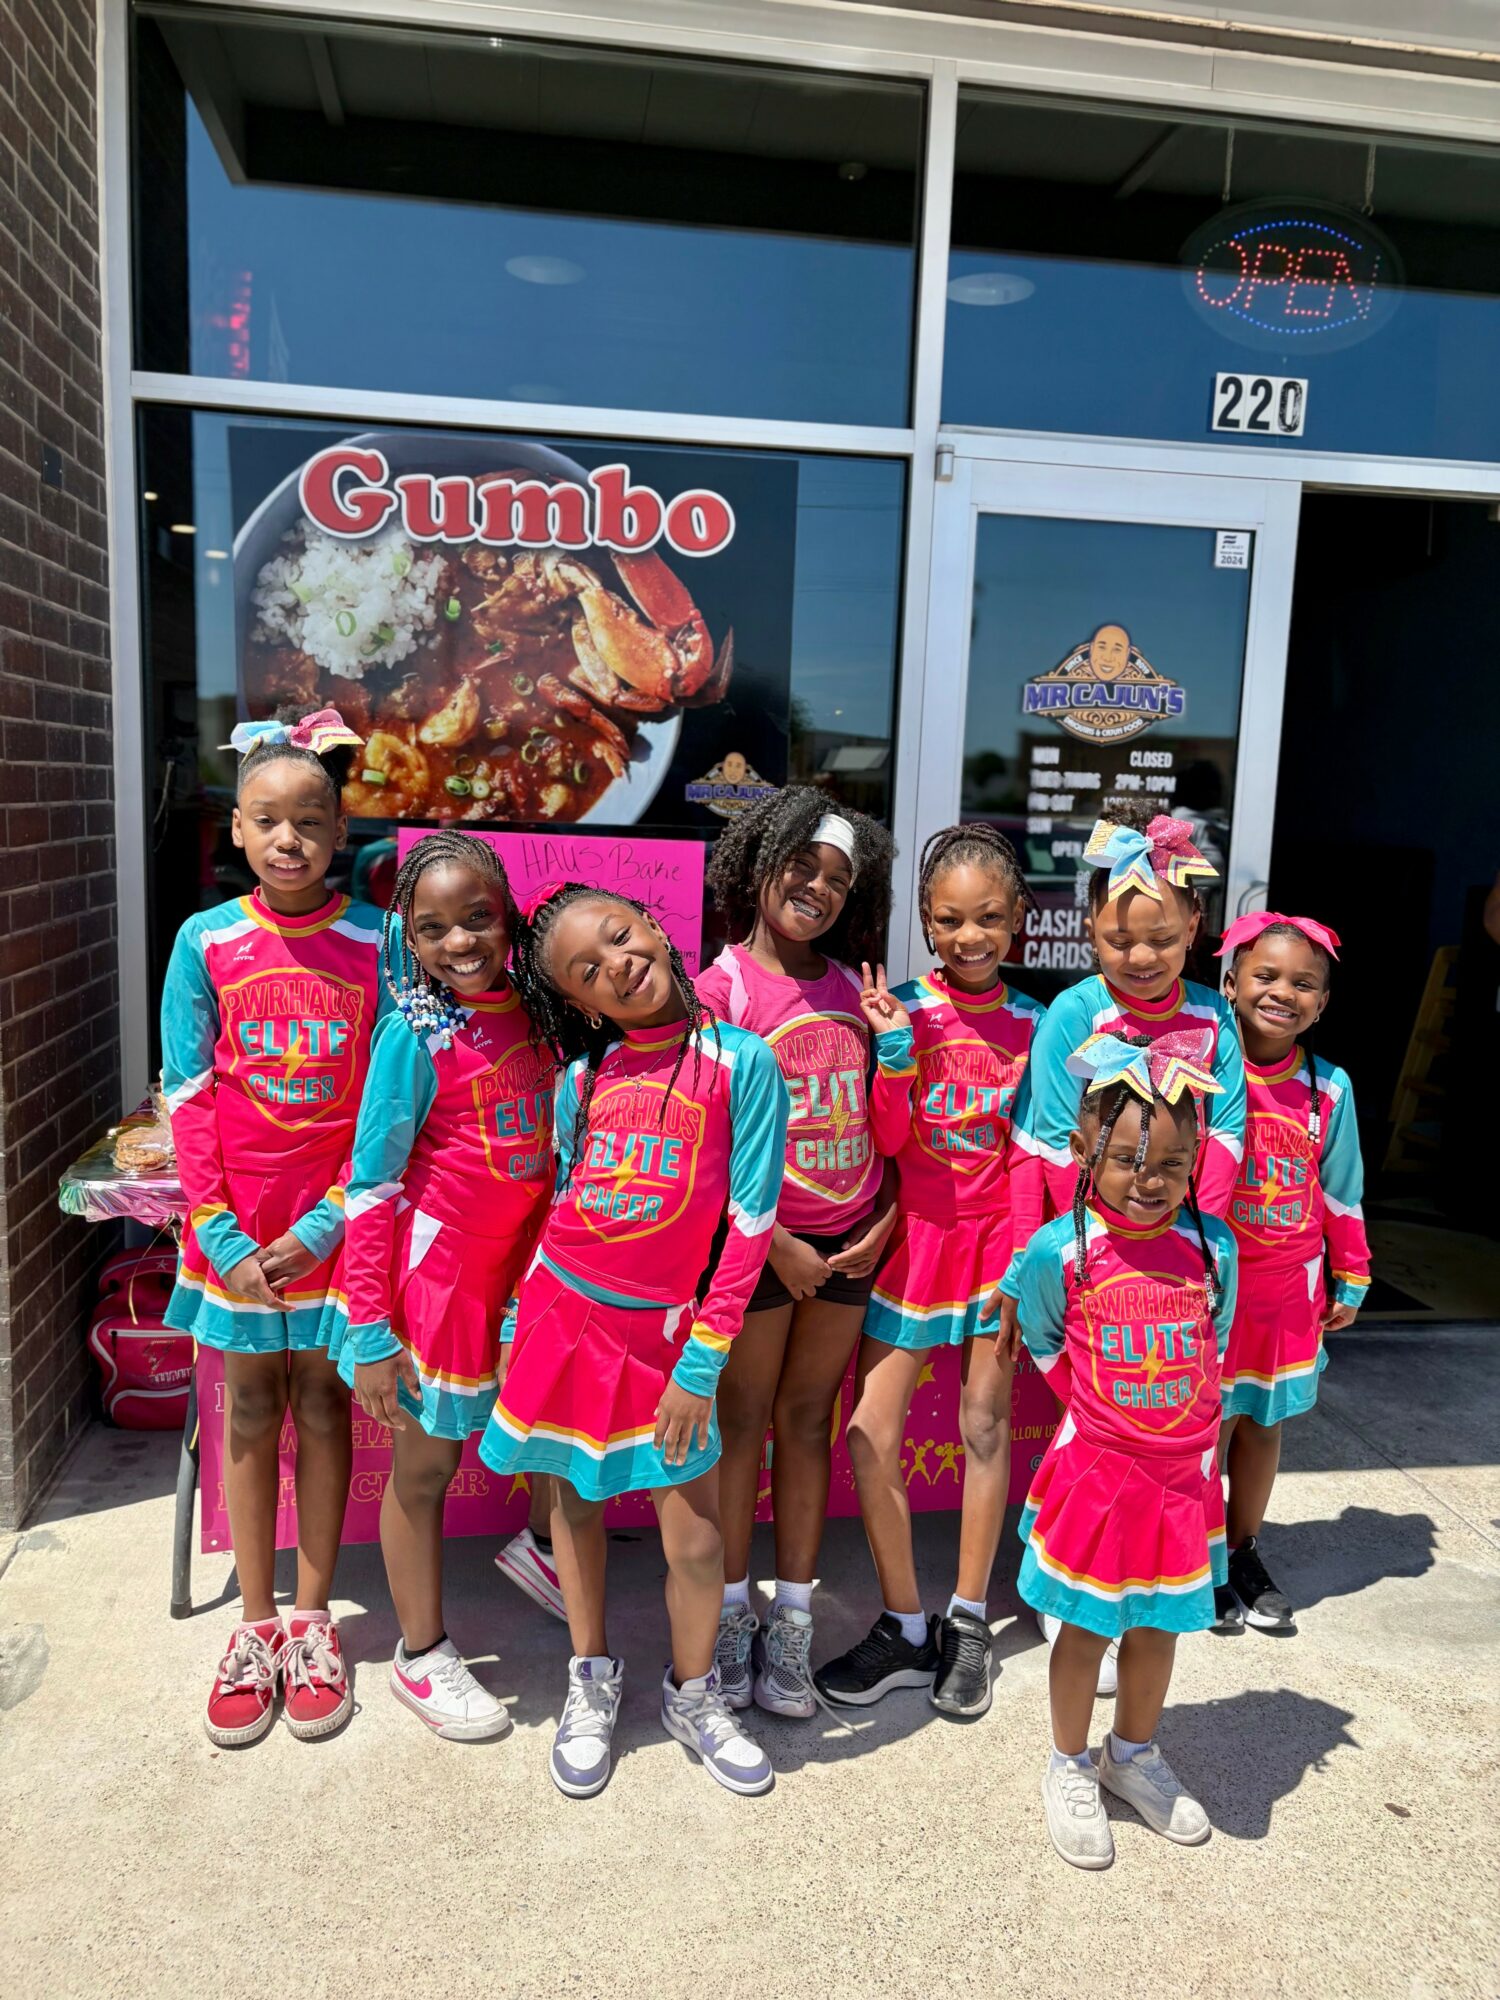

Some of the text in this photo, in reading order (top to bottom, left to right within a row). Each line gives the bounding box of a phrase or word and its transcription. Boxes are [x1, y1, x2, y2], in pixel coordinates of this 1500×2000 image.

[1198, 240, 1380, 320] OPEN
[1217, 376, 1303, 433] 220
[300, 447, 736, 557] Gumbo
[1221, 556, 1243, 565] 2024
[1064, 655, 1083, 672] SINCE
[1023, 683, 1186, 715] MR CAJUN'S
[1124, 718, 1144, 735] FOOD
[1130, 751, 1172, 767] CLOSED
[685, 784, 712, 801] MR
[522, 840, 603, 879] HAUS
[1052, 841, 1082, 857] OPEN
[1025, 909, 1082, 937] CASH
[1024, 940, 1093, 969] CARDS
[225, 980, 359, 1022] PWRHAUS
[239, 1020, 347, 1056] ELITE
[474, 1038, 493, 1050] HYPE
[249, 1073, 336, 1104] CHEER
[786, 1070, 868, 1119] ELIT
[925, 1082, 1016, 1119] ELITE
[495, 1089, 555, 1138] ELIT
[931, 1122, 996, 1152] CHEER
[589, 1131, 683, 1179] ELITE
[1237, 1155, 1308, 1187] LITE
[581, 1182, 663, 1222] CHEER
[1233, 1200, 1302, 1227] CHEER
[1085, 1284, 1207, 1325] PWRHAUS
[1101, 1321, 1197, 1362] ELITE
[1113, 1375, 1191, 1409] CHEER
